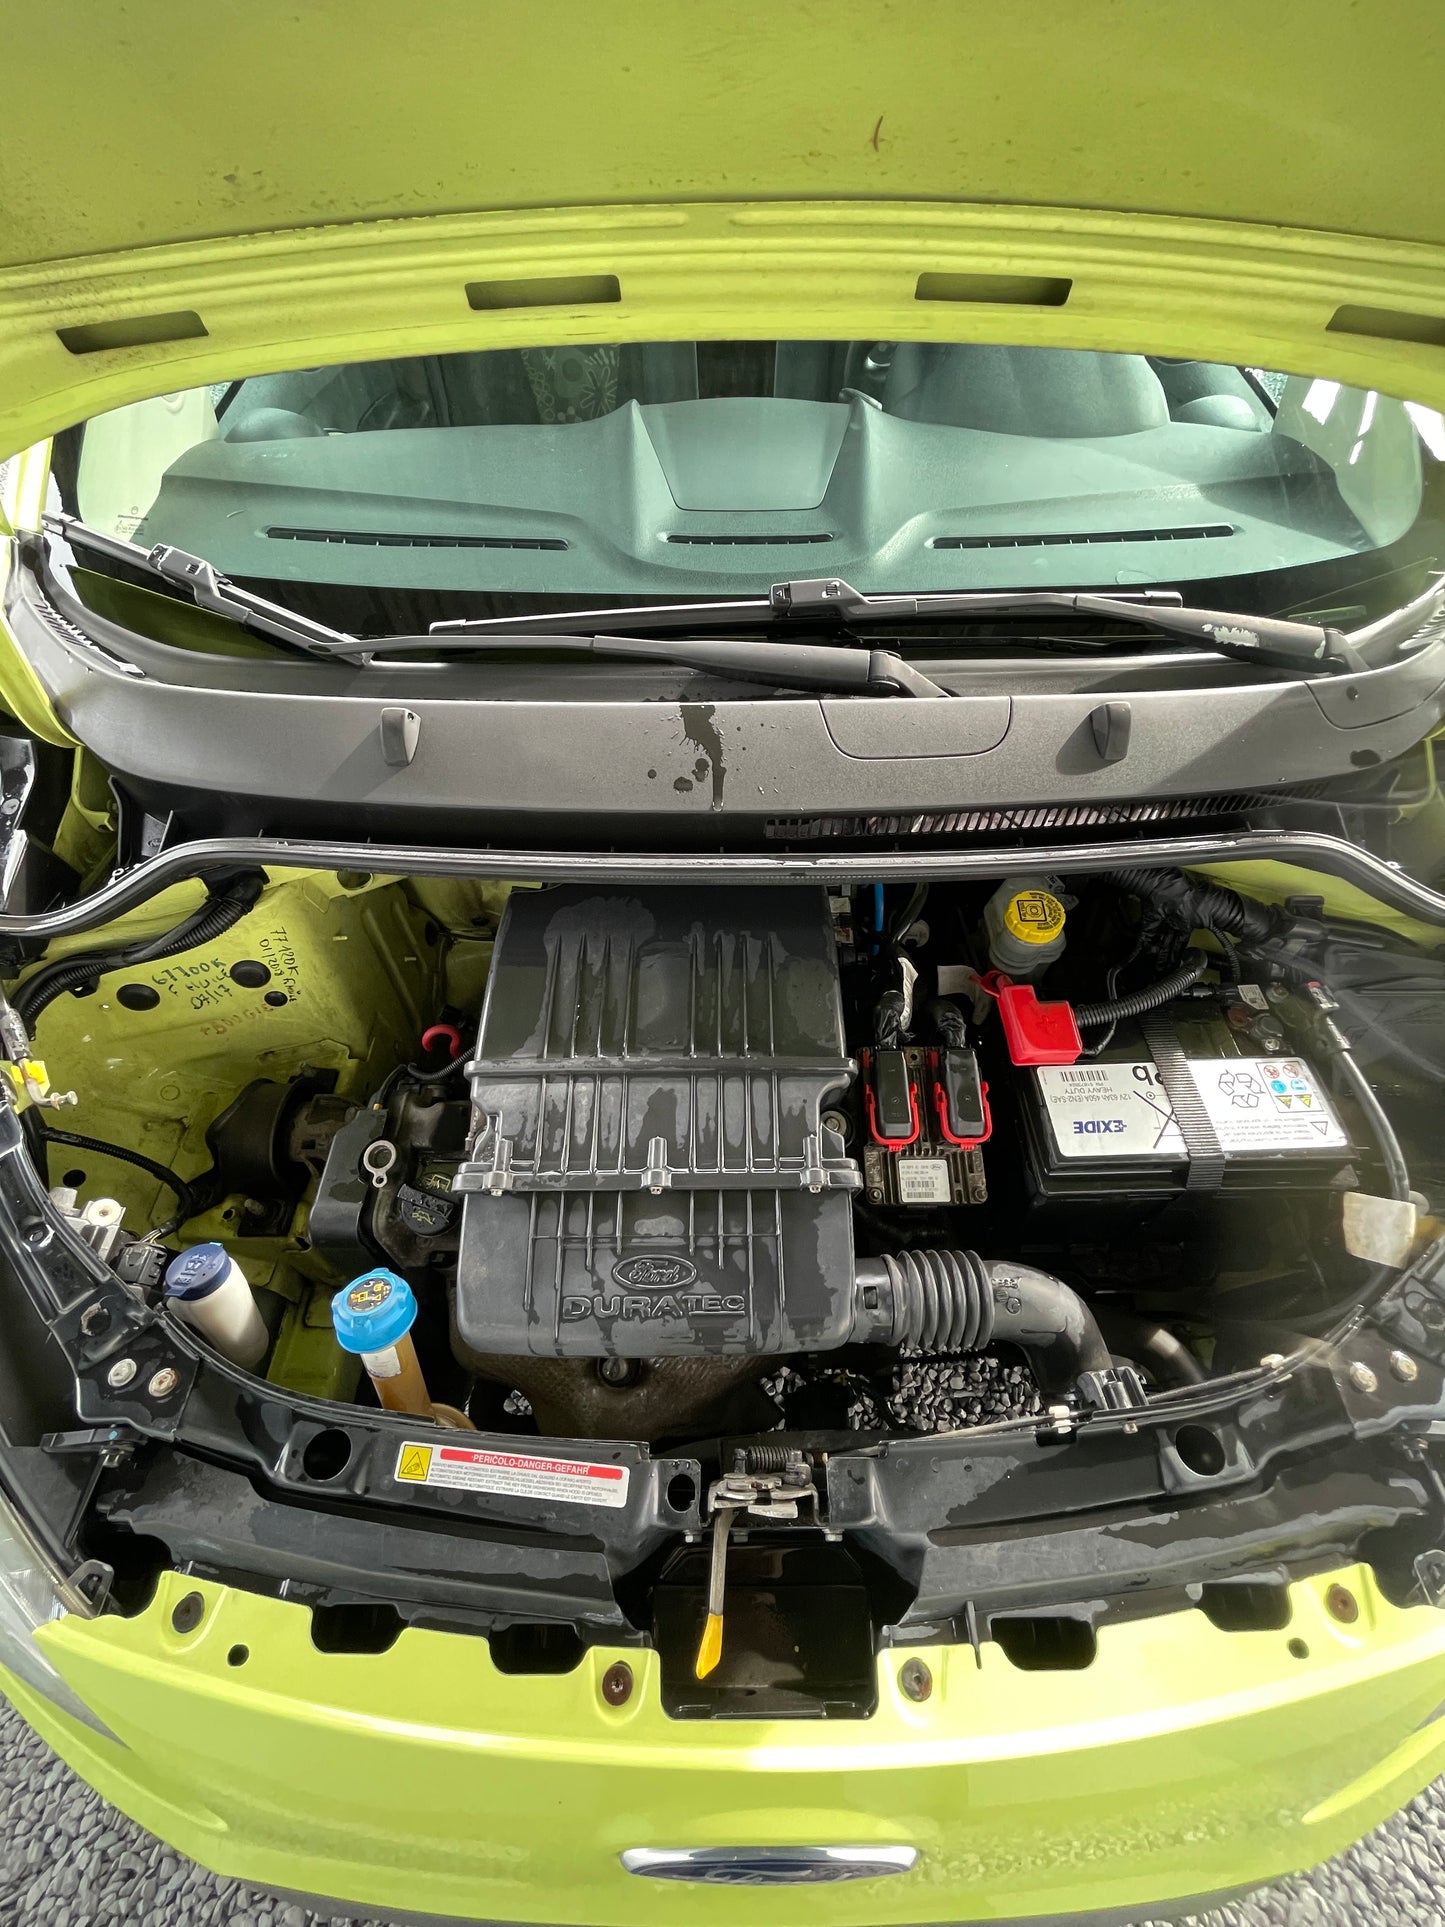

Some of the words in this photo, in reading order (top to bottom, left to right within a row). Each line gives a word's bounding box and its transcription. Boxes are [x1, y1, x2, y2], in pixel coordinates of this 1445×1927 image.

[1064, 1087, 1086, 1095] DUTY
[1073, 1120, 1127, 1134] EXIDE
[628, 1259, 680, 1283] Ford
[562, 1294, 746, 1321] DURATEC
